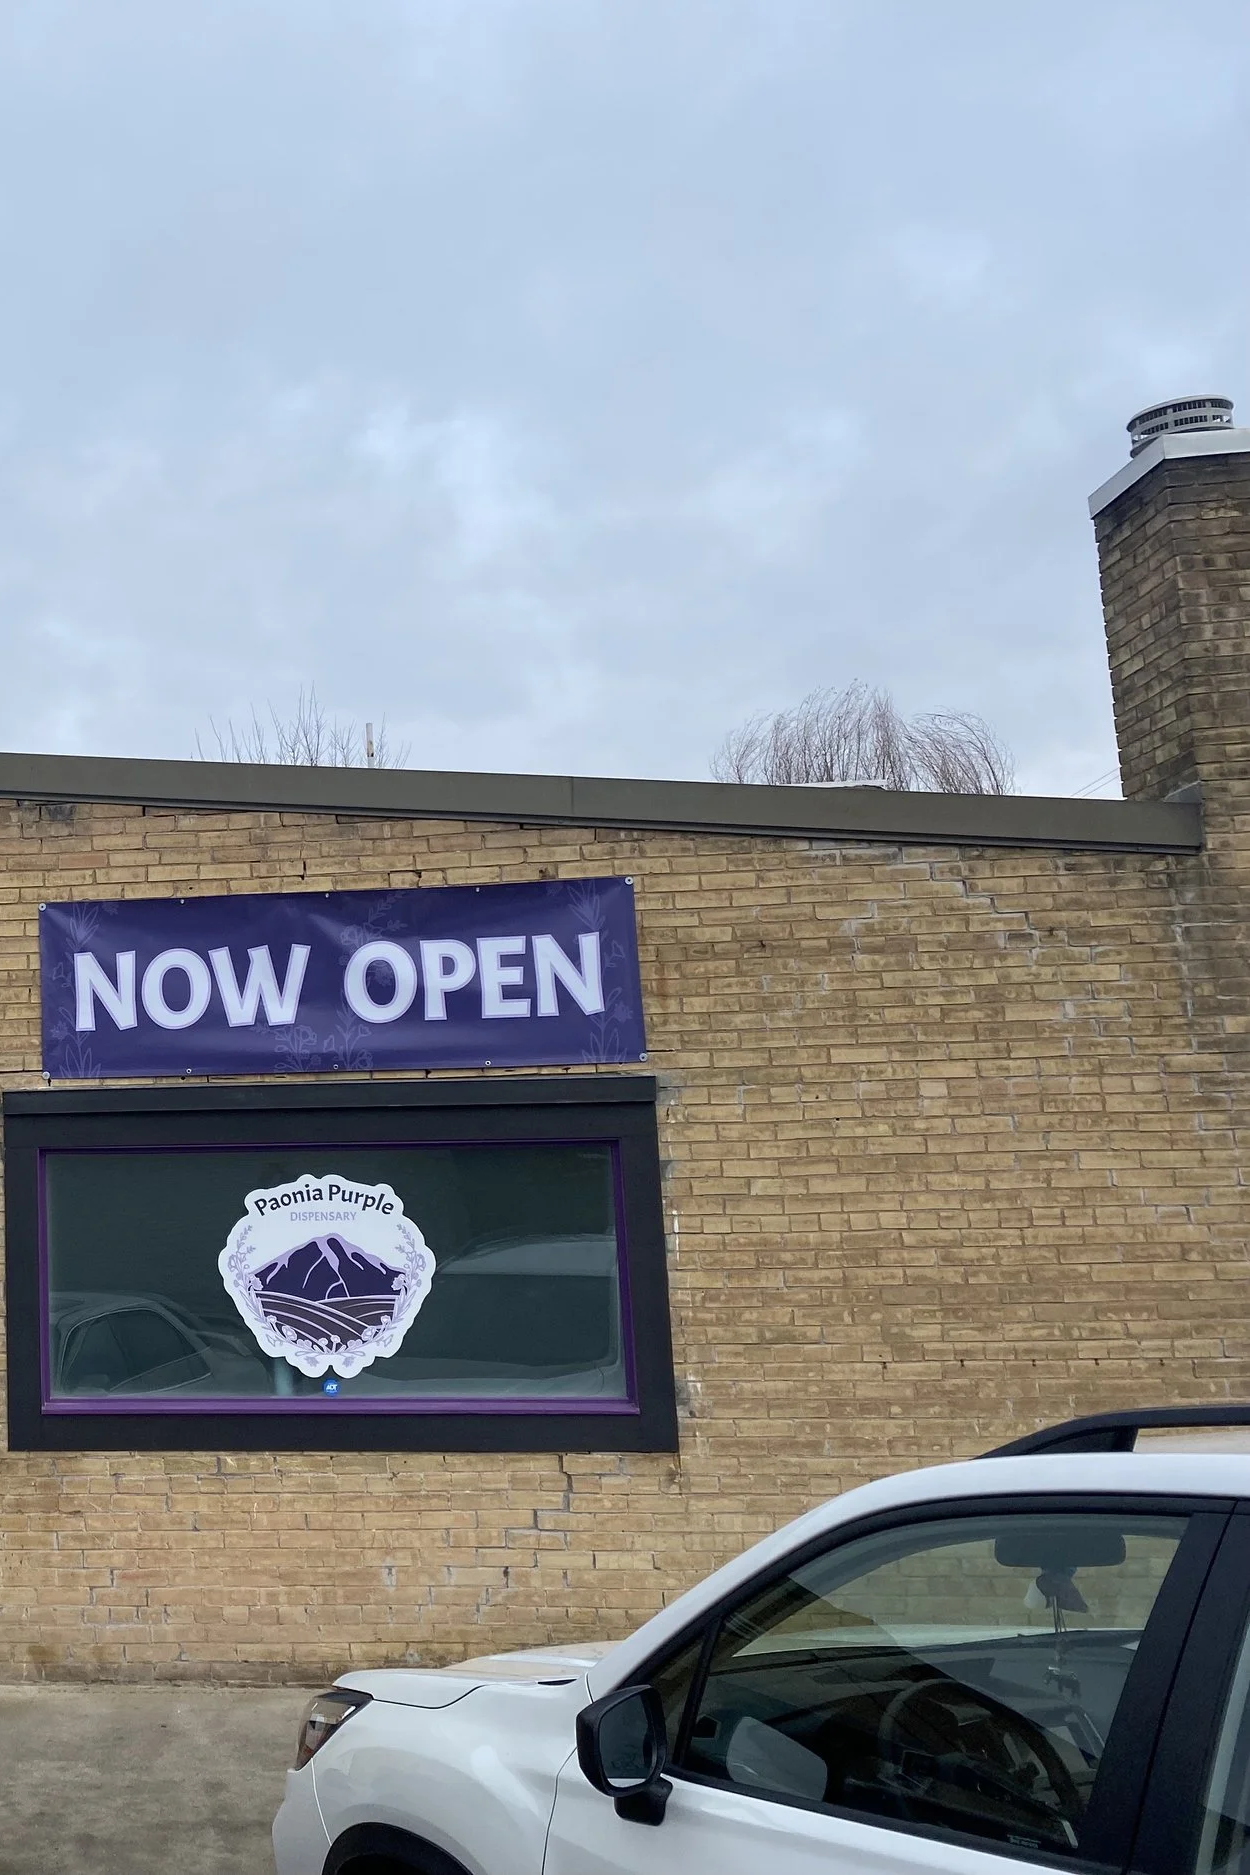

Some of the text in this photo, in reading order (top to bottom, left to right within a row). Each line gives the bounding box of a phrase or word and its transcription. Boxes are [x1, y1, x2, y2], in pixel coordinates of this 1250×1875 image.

[73, 931, 607, 1033] NOW OPEN
[254, 1183, 394, 1217] Paonia Purple
[290, 1211, 357, 1222] DISPENSARY
